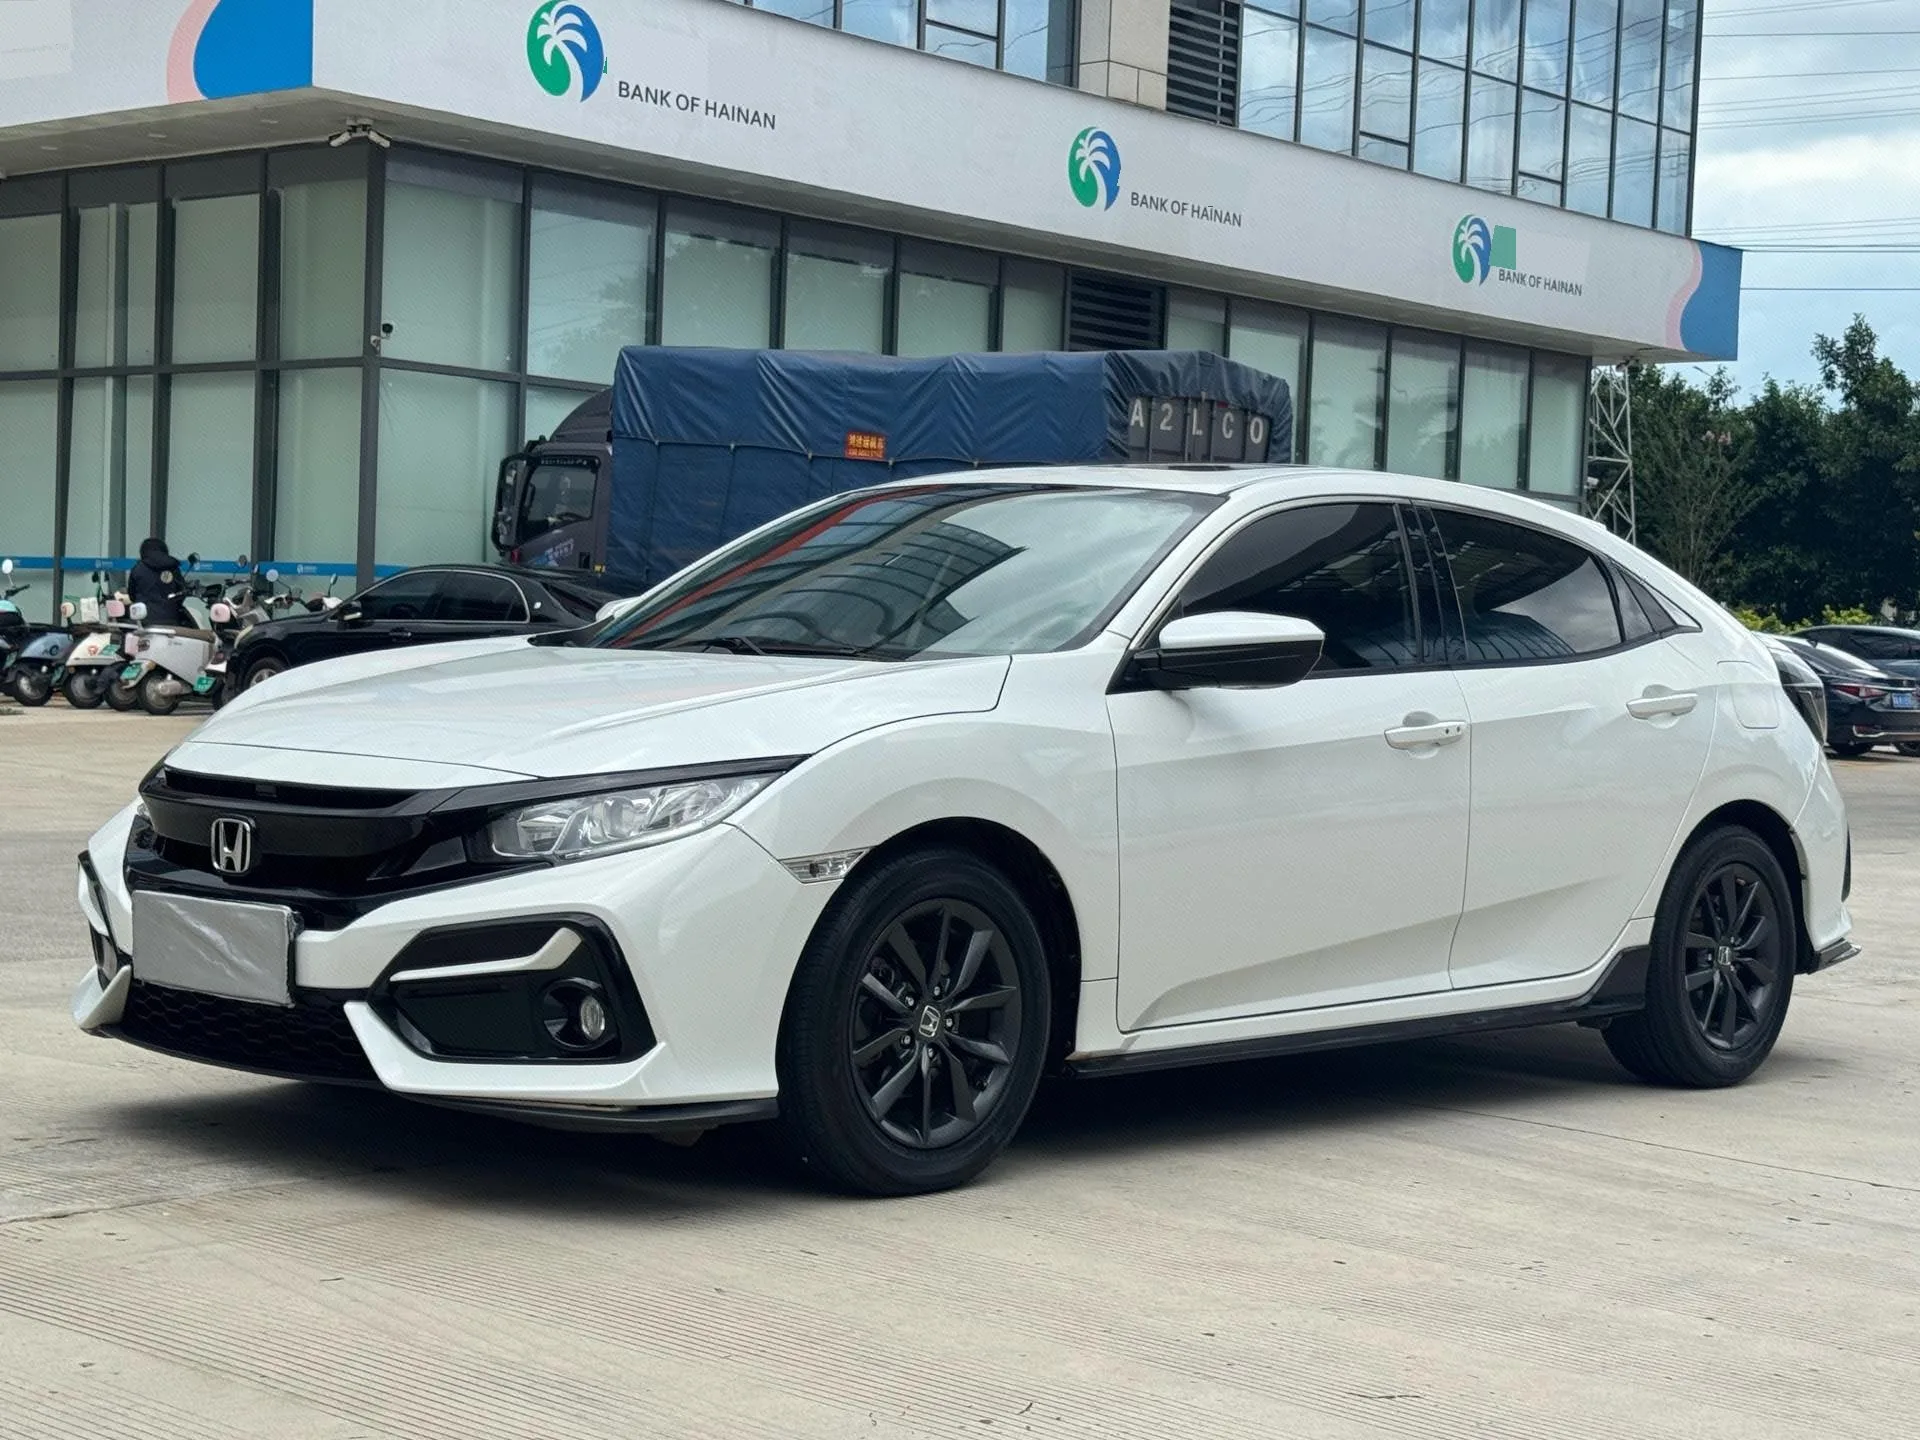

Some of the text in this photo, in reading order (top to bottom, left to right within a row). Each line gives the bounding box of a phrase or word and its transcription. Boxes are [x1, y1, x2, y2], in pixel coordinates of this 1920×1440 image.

[618, 80, 776, 130] BANK OF HAINAN
[1130, 191, 1169, 213] BANK
[1170, 200, 1189, 216] OF
[1498, 269, 1583, 297] BANK OF HAINAN
